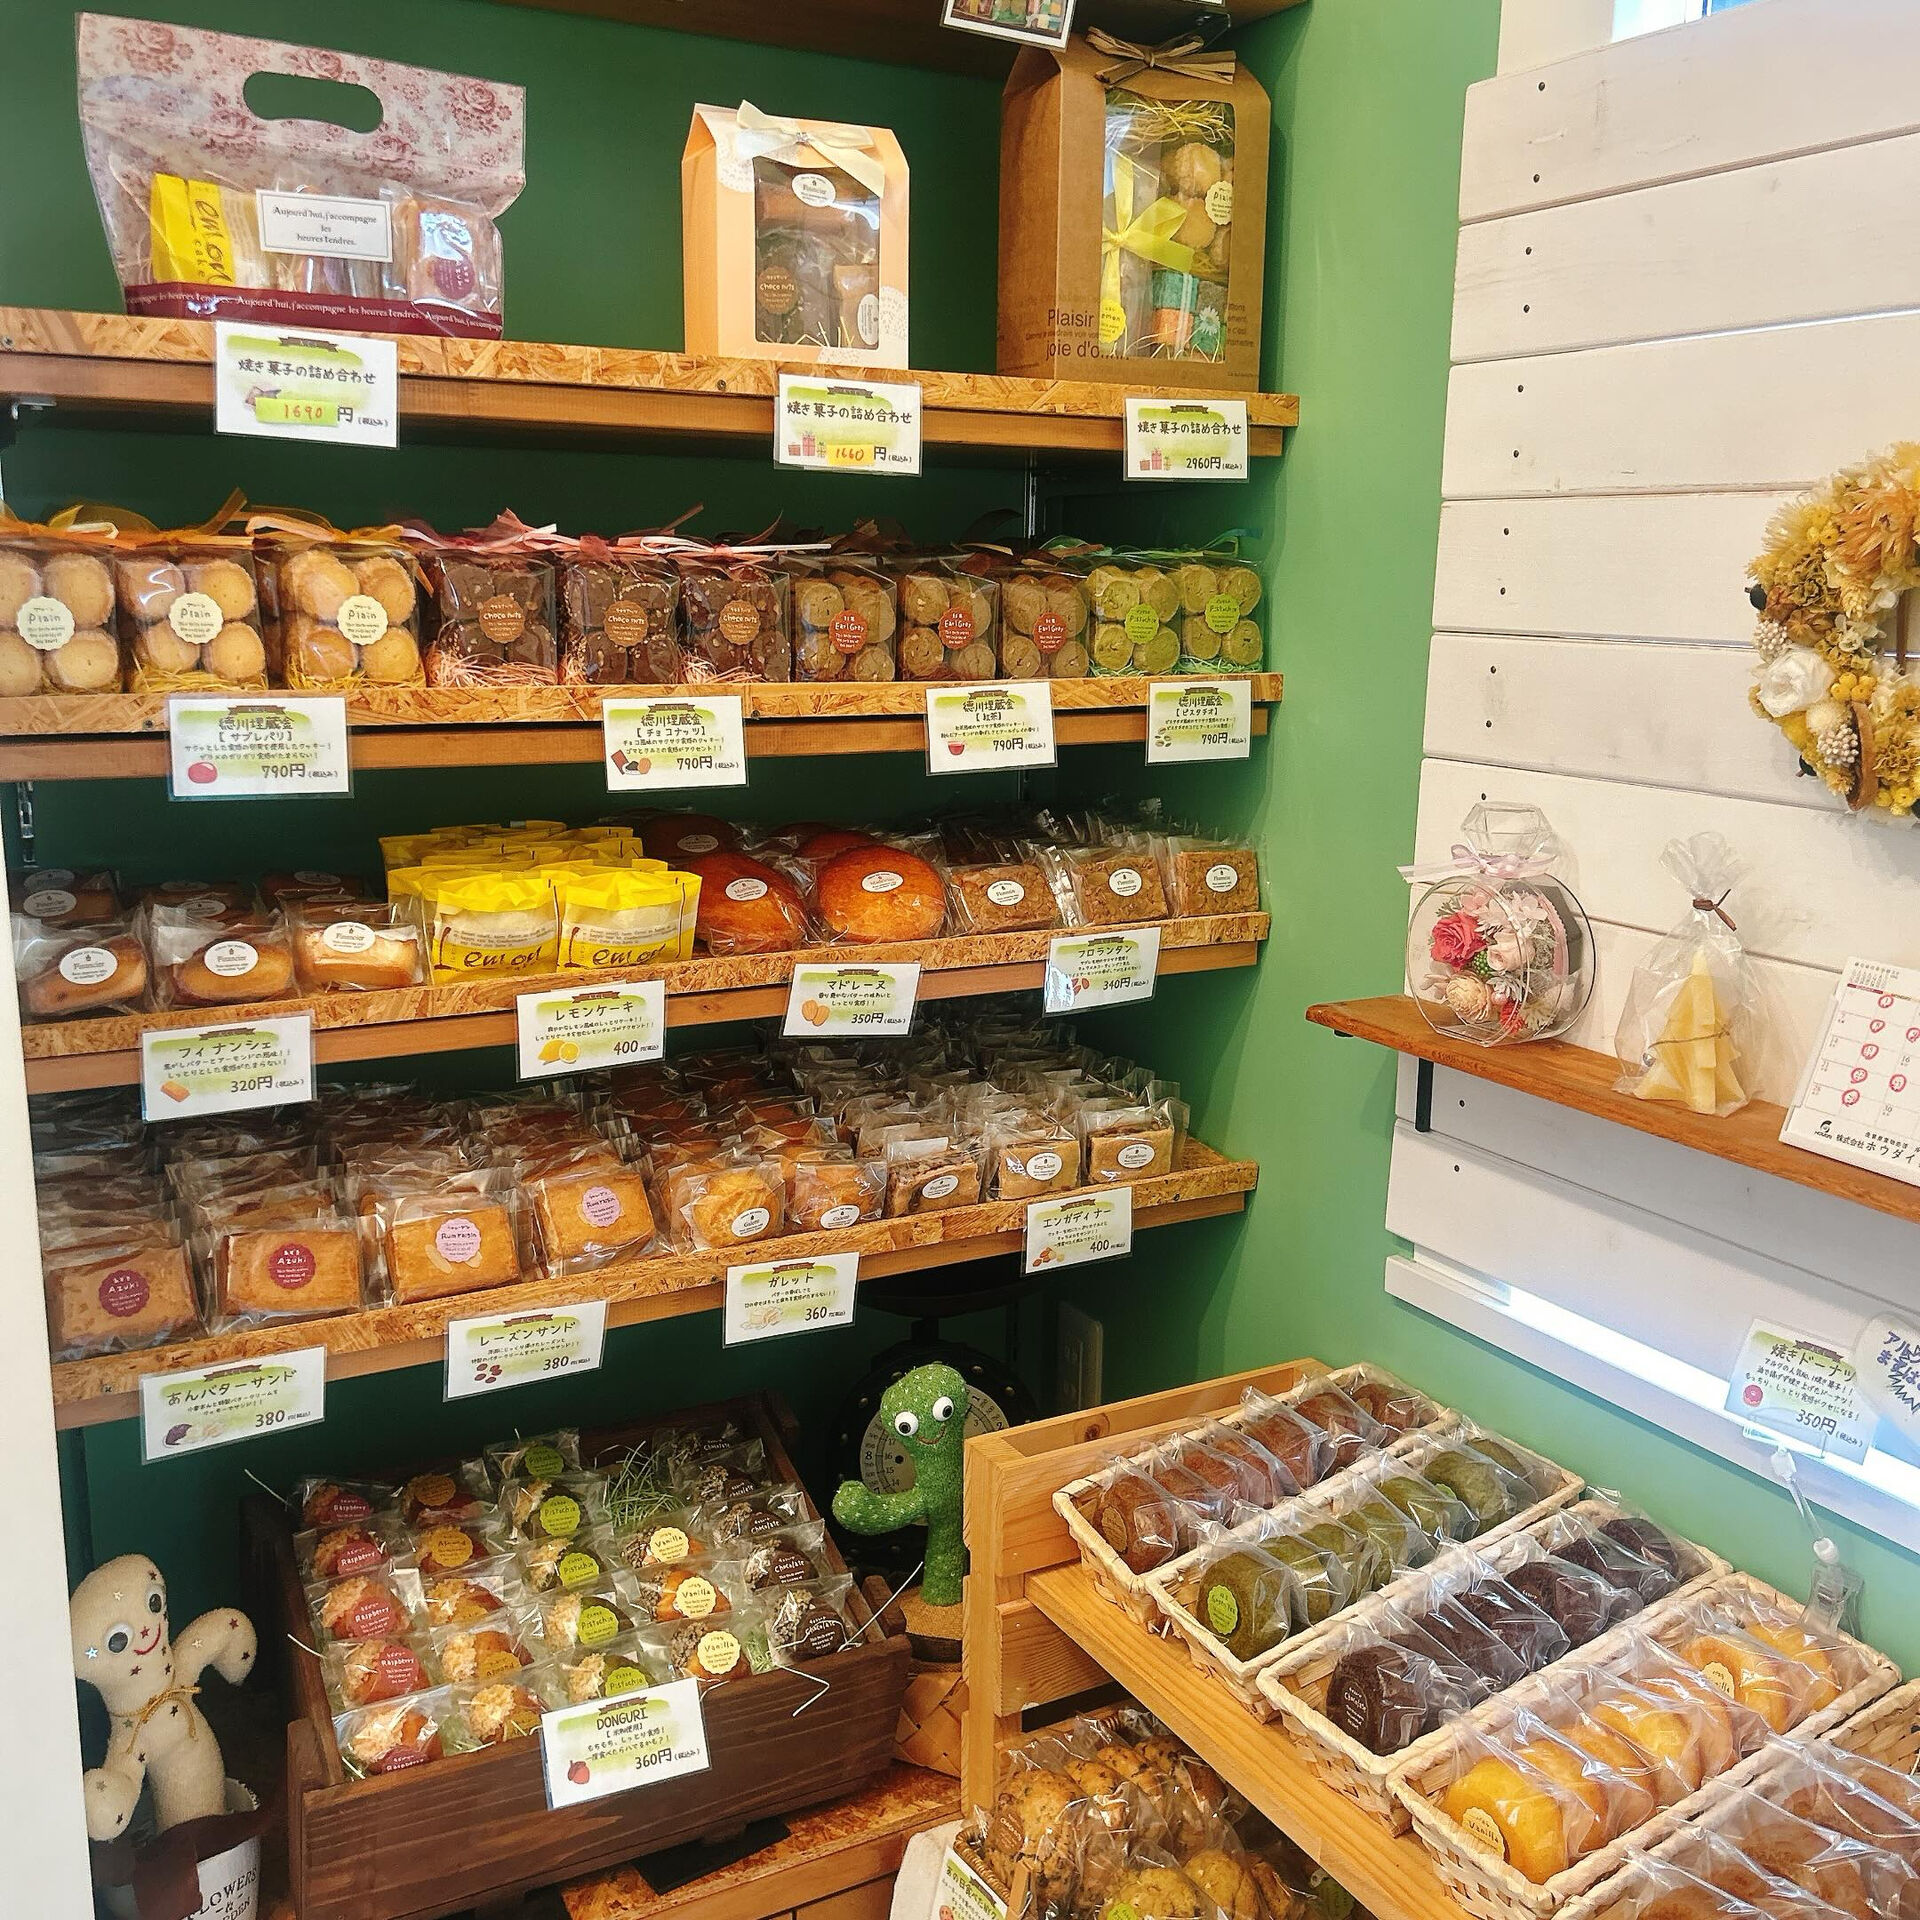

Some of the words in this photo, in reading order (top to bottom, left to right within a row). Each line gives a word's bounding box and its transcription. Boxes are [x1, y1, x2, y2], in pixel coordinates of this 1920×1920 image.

[320, 225, 332, 233] les
[296, 233, 324, 244] heures
[348, 305, 360, 314] les
[360, 306, 388, 316] heures
[1047, 309, 1095, 328] Plaisir
[1046, 341, 1071, 361] joie
[238, 358, 376, 385] 焼き菓子の詰め合わせ
[284, 404, 324, 420] 1690
[337, 406, 354, 423] 円
[787, 400, 912, 424] 焼き菓子の詰め合わせ
[1138, 421, 1241, 435] 焼き菓子の詰め合わせ
[836, 447, 865, 461] 1660
[873, 446, 887, 461] 円
[1186, 457, 1221, 470] 2960円
[28, 613, 61, 624] Plain
[181, 608, 211, 618] Plain
[348, 609, 377, 620] Plain
[963, 698, 1015, 713] 徳川埋蔵金
[1178, 695, 1223, 707] 徳川埋蔵金
[641, 712, 703, 727] 徳川埋蔵金
[1176, 708, 1218, 717] 【ピスタチオ】
[218, 716, 295, 731] 徳川埋蔵金
[636, 726, 706, 738] 【チョコナッツ】
[1202, 732, 1228, 745] 790円
[993, 737, 1024, 752] 790円
[677, 755, 713, 770] 790円
[261, 763, 306, 778] 790円
[1078, 945, 1133, 958] フロランタン
[827, 979, 886, 991] マドレーヌ
[1103, 977, 1131, 991] 340円
[555, 1001, 634, 1021] レモンケーキ
[851, 1012, 884, 1024] 350円
[179, 1040, 272, 1059] フィナンシェ
[613, 1040, 639, 1056] 400
[231, 1075, 272, 1093] 320円
[1836, 1133, 1865, 1150] 株式会社
[1043, 1207, 1111, 1228] エンガディナー
[1090, 1239, 1110, 1253] 400
[277, 1256, 307, 1265] Azuki
[768, 1272, 814, 1288] ガレット
[108, 1282, 139, 1294] Azuki
[804, 1306, 828, 1321] 360
[480, 1321, 576, 1347] レーズンサンド
[542, 1355, 569, 1371] 380
[1770, 1343, 1857, 1382] 焼きドーナツ
[168, 1369, 297, 1406] あんバターサンド
[255, 1409, 285, 1428] 380
[1796, 1408, 1838, 1436] 350円
[654, 1534, 683, 1548] Vanilla
[341, 1551, 377, 1566] Raspberry
[774, 1559, 805, 1573] Chocolate
[682, 1588, 711, 1598] Vanilla
[354, 1606, 391, 1623] Raspberry
[581, 1616, 614, 1629] Pistachio
[704, 1641, 735, 1652] Vanilla
[381, 1657, 415, 1667] Raspberry
[609, 1678, 643, 1689] Pistachio
[597, 1707, 649, 1731] DONGURI
[635, 1747, 672, 1770] 360円
[1469, 1822, 1499, 1843] Vanilla
